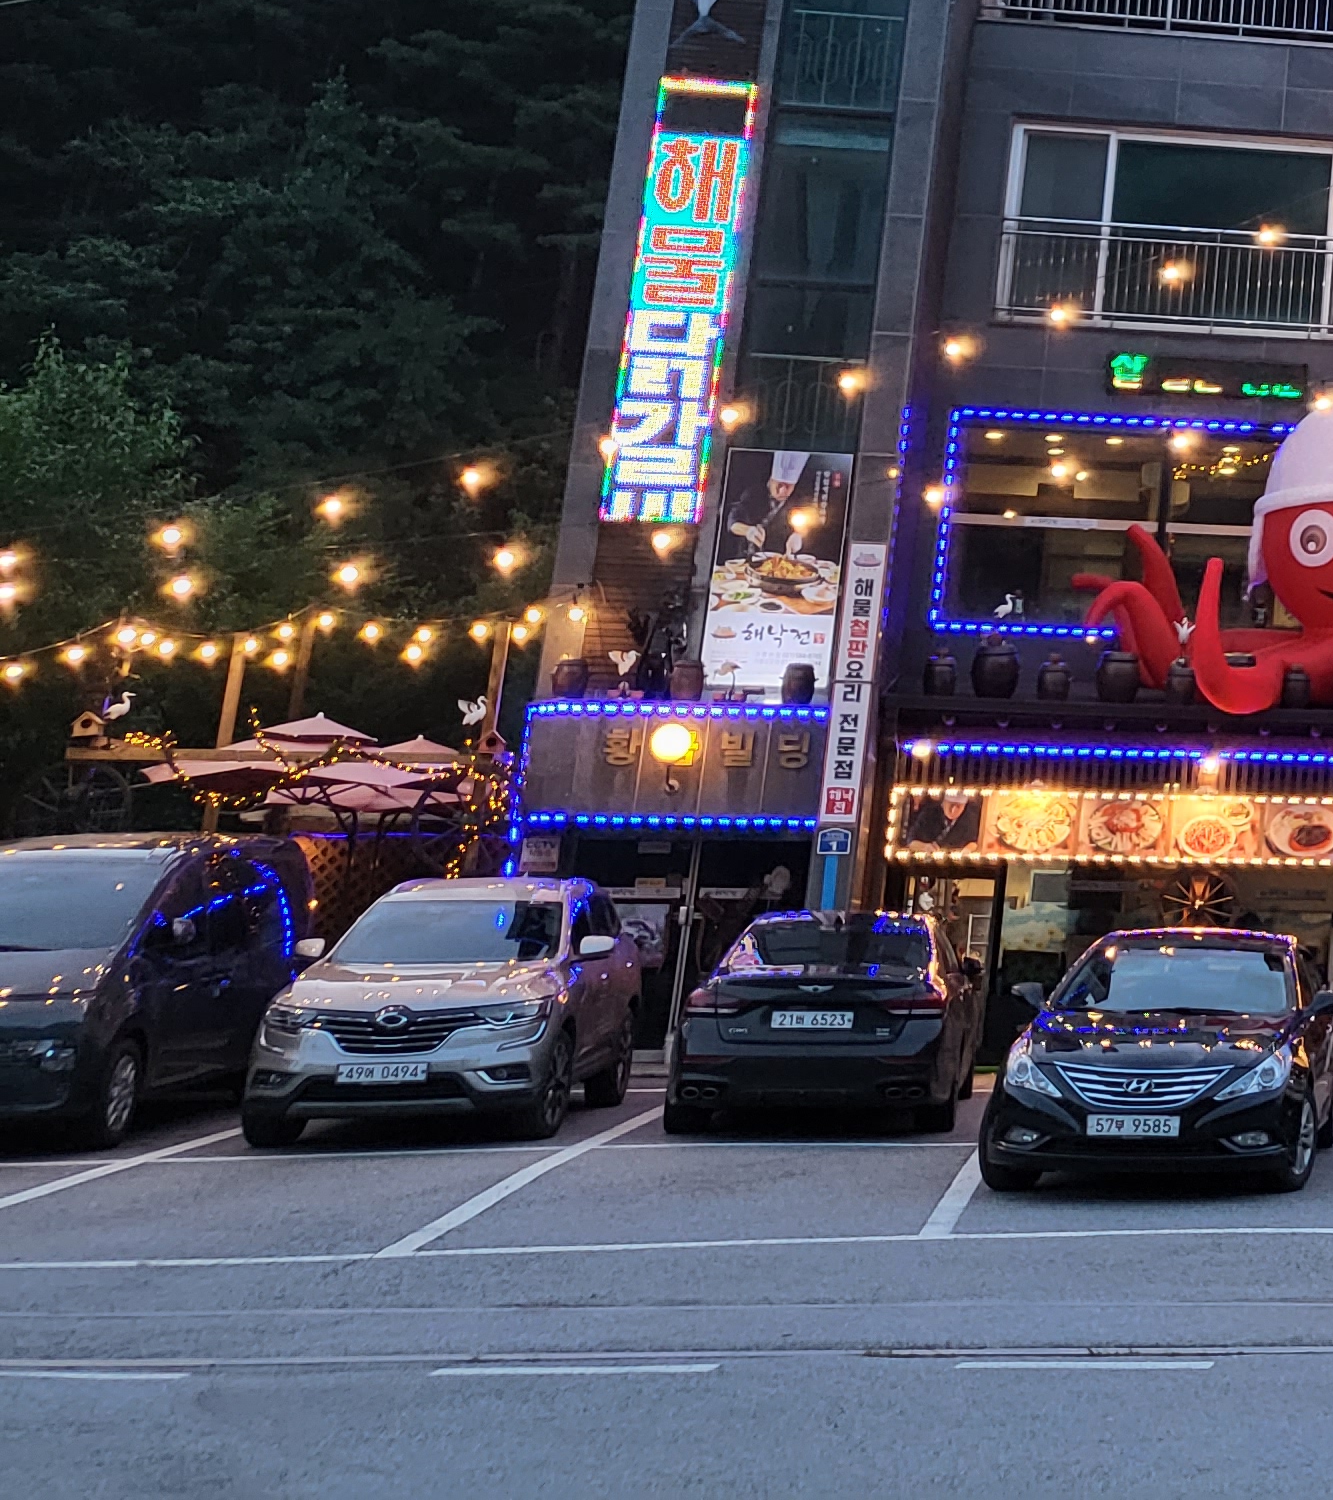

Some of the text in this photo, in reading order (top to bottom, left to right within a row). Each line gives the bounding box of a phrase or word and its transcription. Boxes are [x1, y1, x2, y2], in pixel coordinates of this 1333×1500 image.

[742, 622, 811, 649] 해낙전
[833, 577, 875, 780] 해물철판요리 전문점
[811, 1013, 846, 1026] 6523
[381, 1065, 419, 1079] 0494
[1132, 1118, 1172, 1134] 9585
